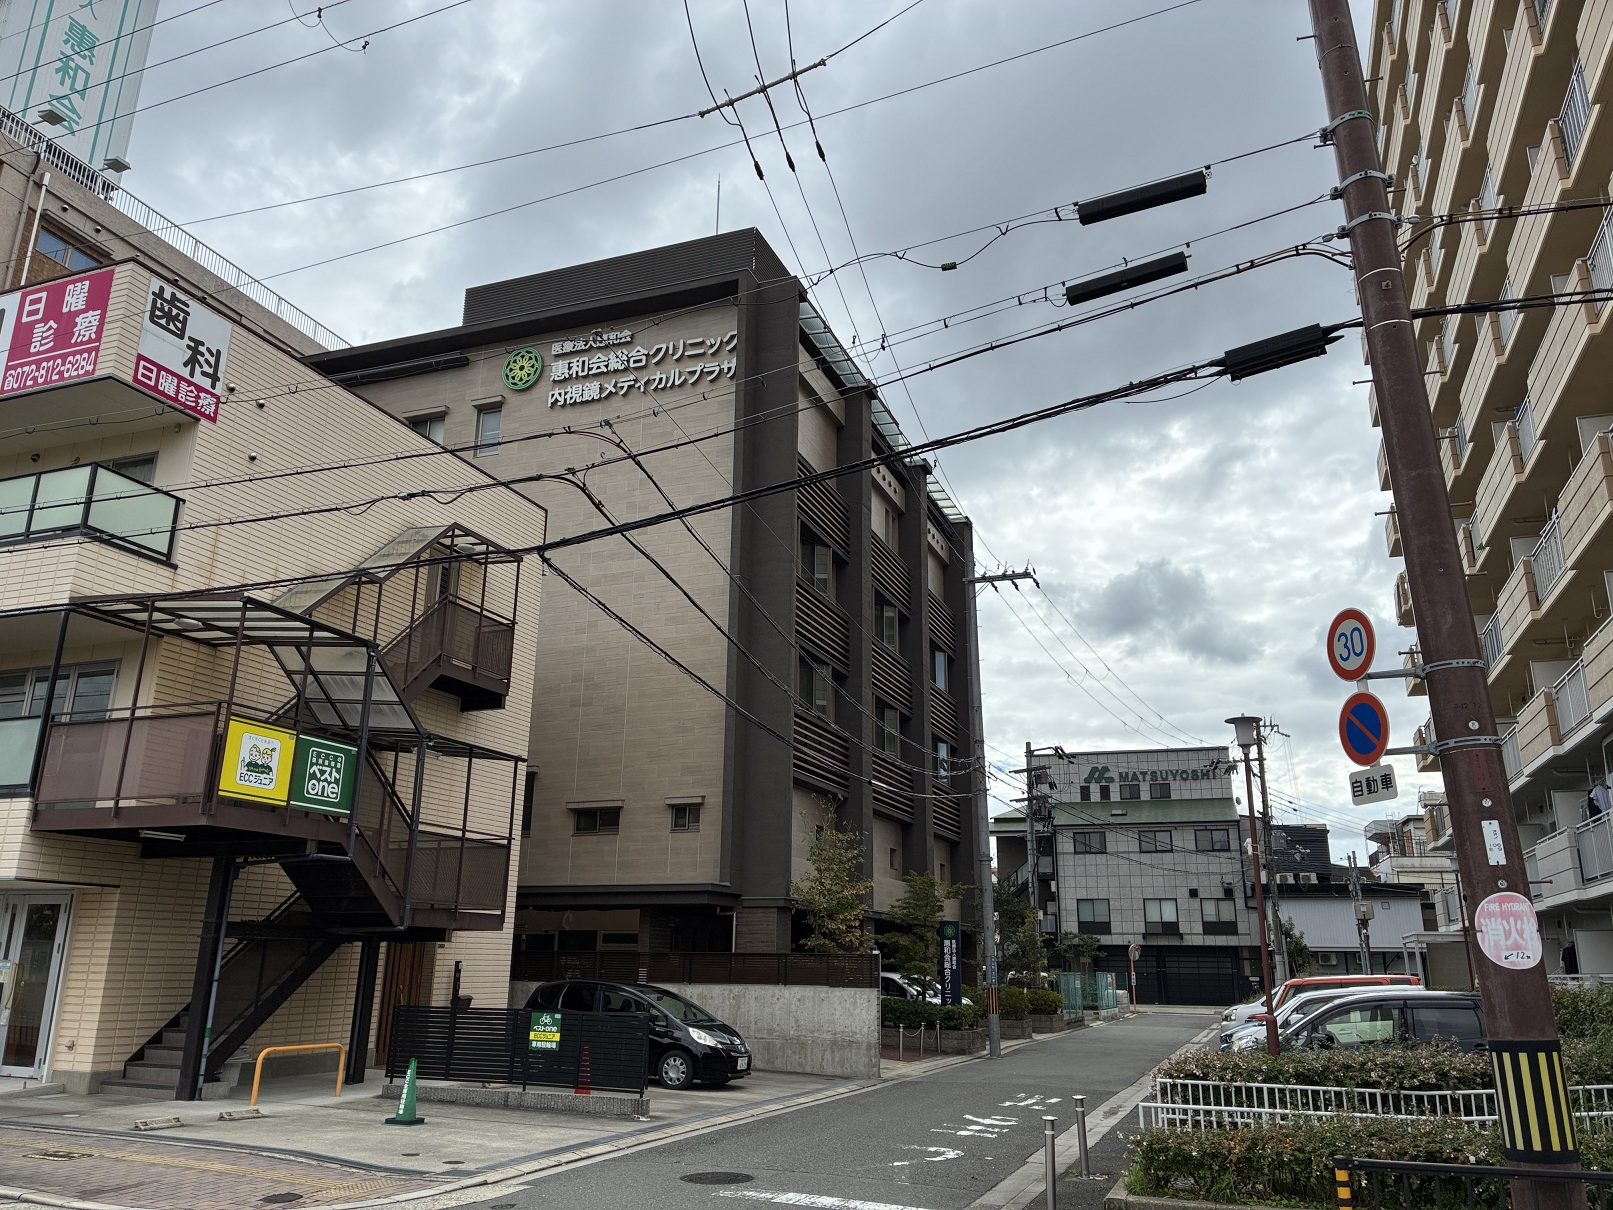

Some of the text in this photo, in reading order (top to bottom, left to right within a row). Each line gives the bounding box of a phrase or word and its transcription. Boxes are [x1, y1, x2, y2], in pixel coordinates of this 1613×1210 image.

[149, 285, 222, 390] 歯科
[12, 351, 96, 390] 072-812-6284
[138, 360, 220, 417] 日曜診療
[1337, 626, 1365, 662] 30
[310, 765, 340, 782] ベスト
[1118, 769, 1217, 782] MATSUYOSHI
[1351, 772, 1394, 798] 自動車
[308, 780, 339, 798] one
[1484, 902, 1530, 911] FIRE HYDRANT
